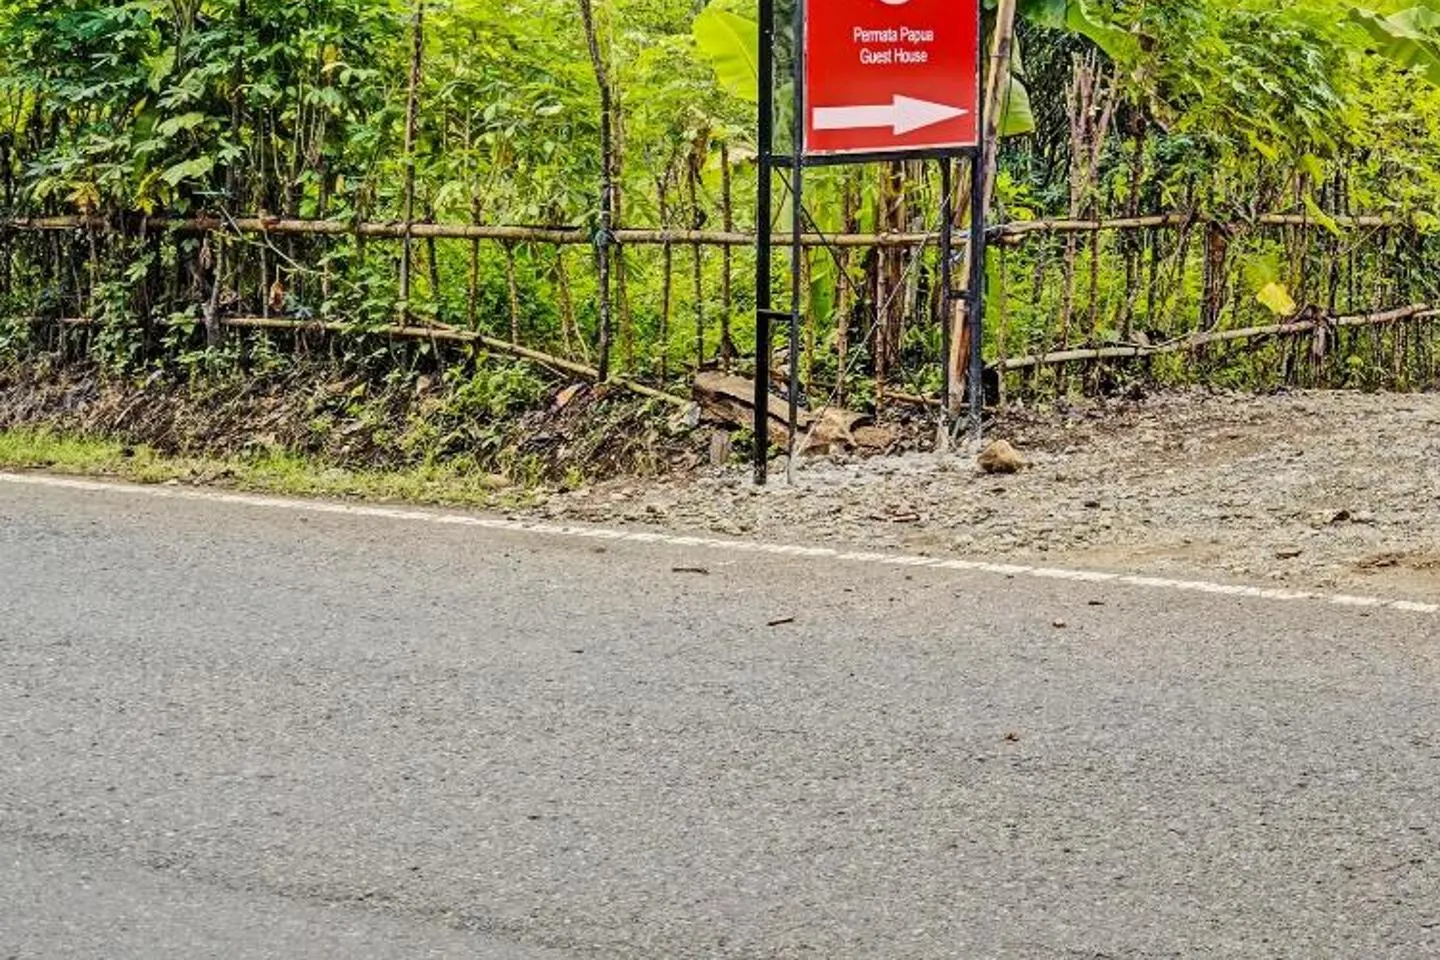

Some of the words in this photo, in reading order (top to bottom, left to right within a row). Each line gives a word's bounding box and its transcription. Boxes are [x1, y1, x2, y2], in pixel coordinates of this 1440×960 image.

[853, 26, 898, 42] Permata
[900, 26, 934, 44] Papua
[860, 48, 892, 64] Guest
[894, 48, 928, 63] House
